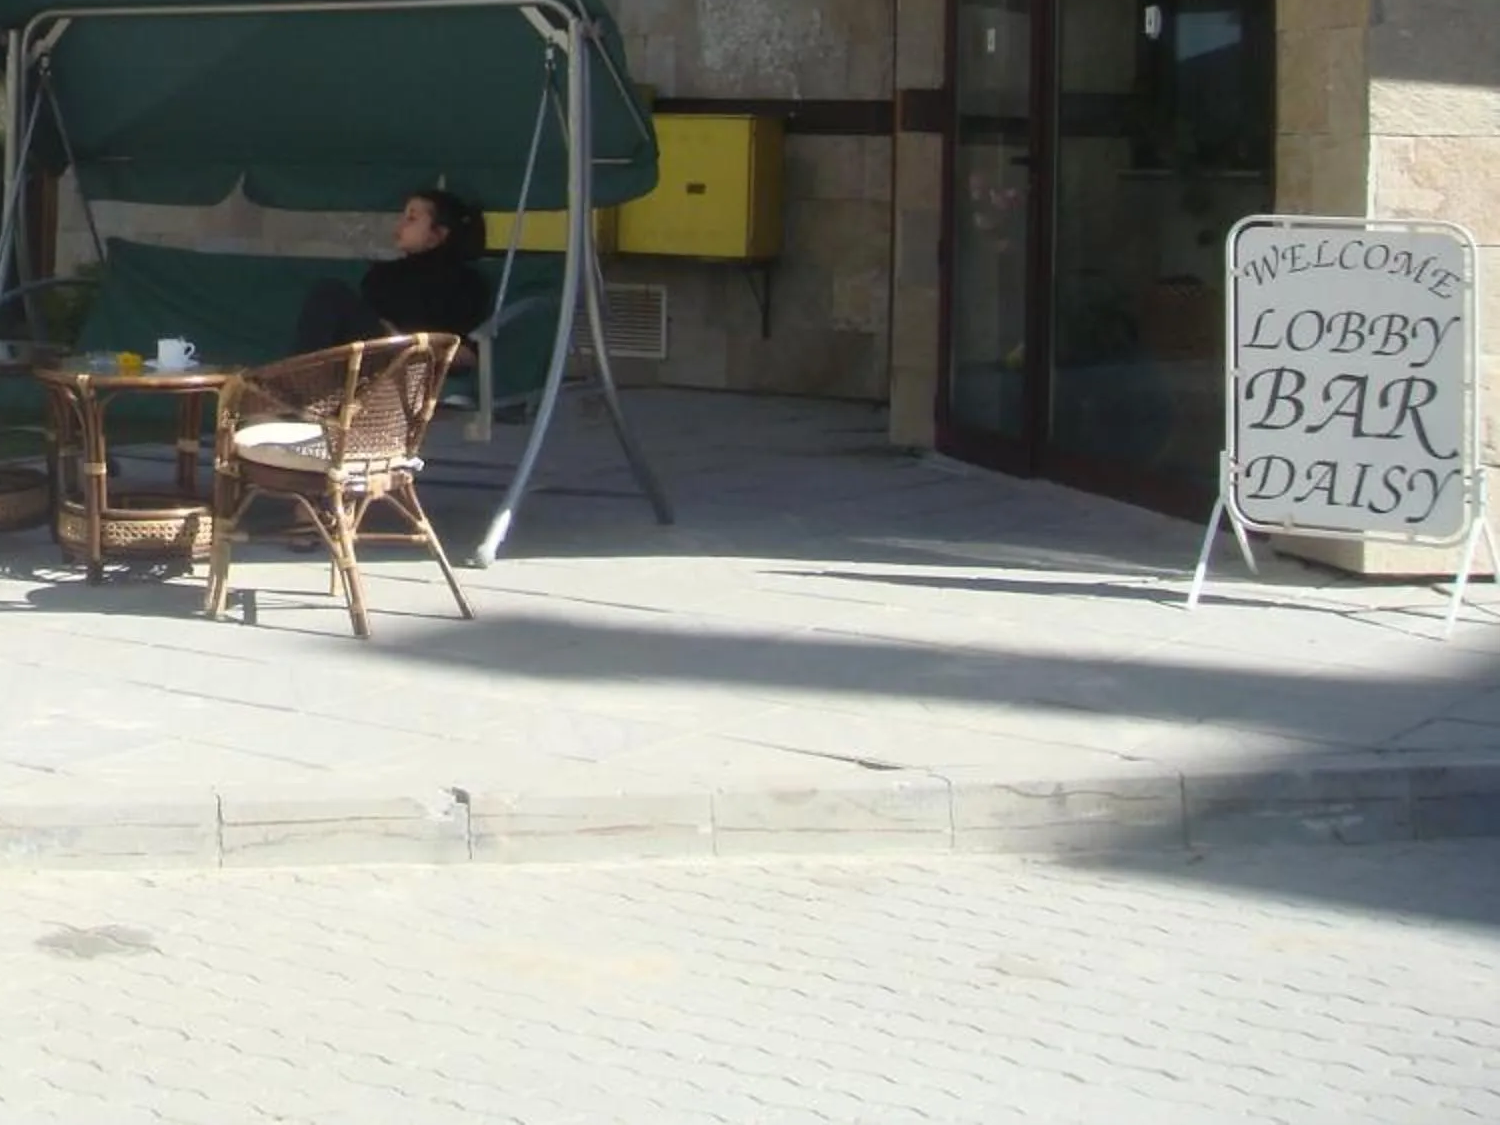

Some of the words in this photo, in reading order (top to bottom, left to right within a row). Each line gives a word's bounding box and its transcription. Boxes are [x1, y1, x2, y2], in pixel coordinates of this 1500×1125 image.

[1244, 240, 1462, 299] WELCOME
[1243, 308, 1461, 367] LOBBY
[1245, 366, 1459, 460] BAR
[1244, 454, 1461, 523] DAISY
